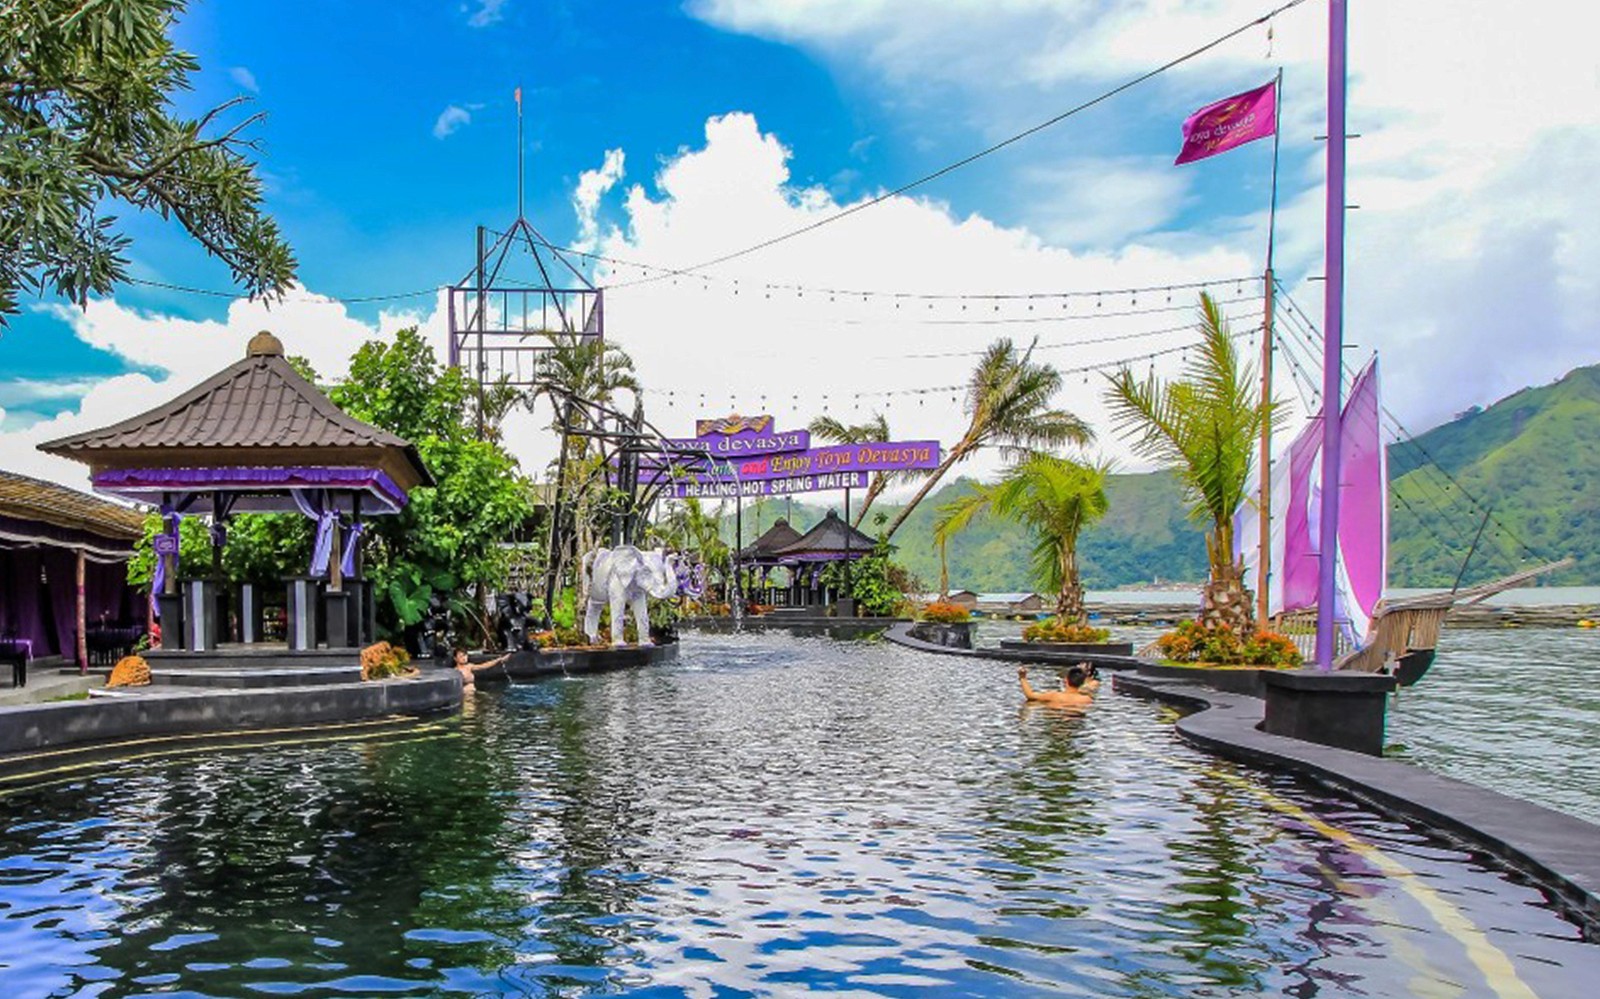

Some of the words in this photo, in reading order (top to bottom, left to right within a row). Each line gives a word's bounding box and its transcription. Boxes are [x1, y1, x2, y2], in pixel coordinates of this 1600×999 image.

[718, 434, 800, 452] devasya
[741, 453, 770, 475] and
[771, 455, 812, 477] Enjoy
[815, 450, 851, 473] Toya
[857, 447, 931, 468] Devasya
[685, 481, 737, 497] HEALING
[743, 480, 766, 495] HOT
[770, 476, 812, 494] SPRING
[817, 472, 860, 489] WATER
